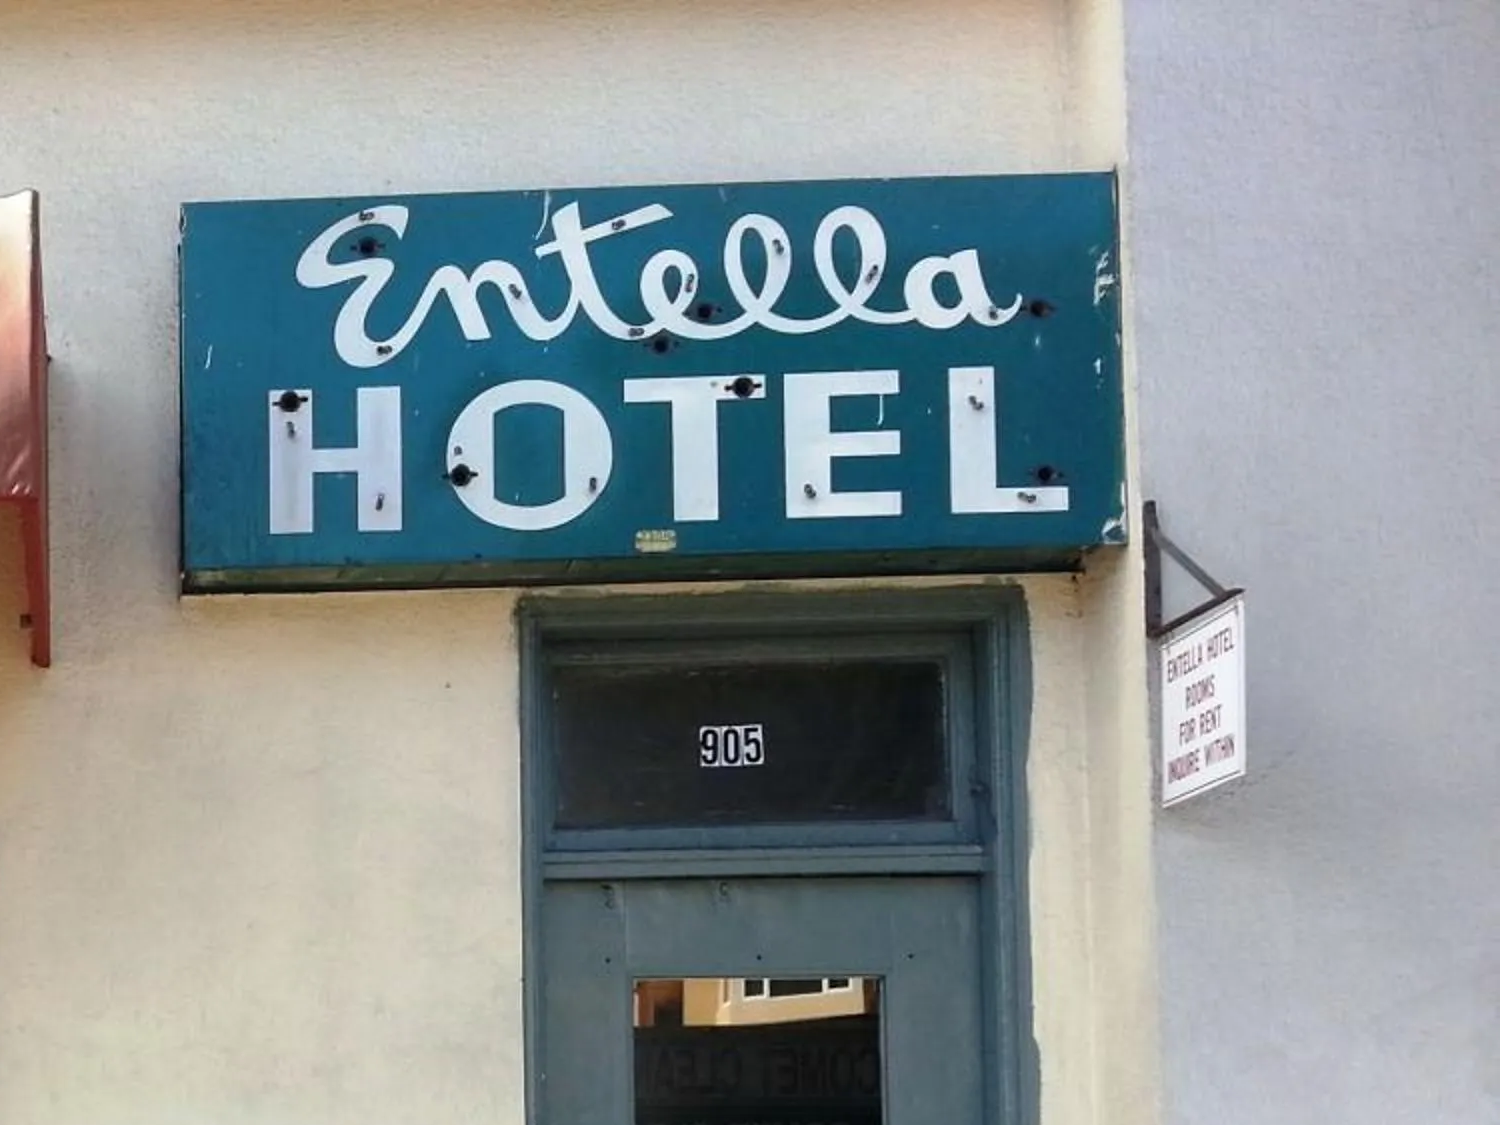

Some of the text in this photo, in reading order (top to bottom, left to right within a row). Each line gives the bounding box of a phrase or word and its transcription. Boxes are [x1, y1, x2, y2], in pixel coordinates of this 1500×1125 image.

[295, 203, 1022, 367] Entella
[269, 366, 1069, 534] HOTEL
[1167, 626, 1235, 683] ENTELLA HOTEL
[1186, 673, 1215, 710] ROOMS
[701, 727, 762, 765] 905
[1179, 704, 1222, 747] FOR RENT
